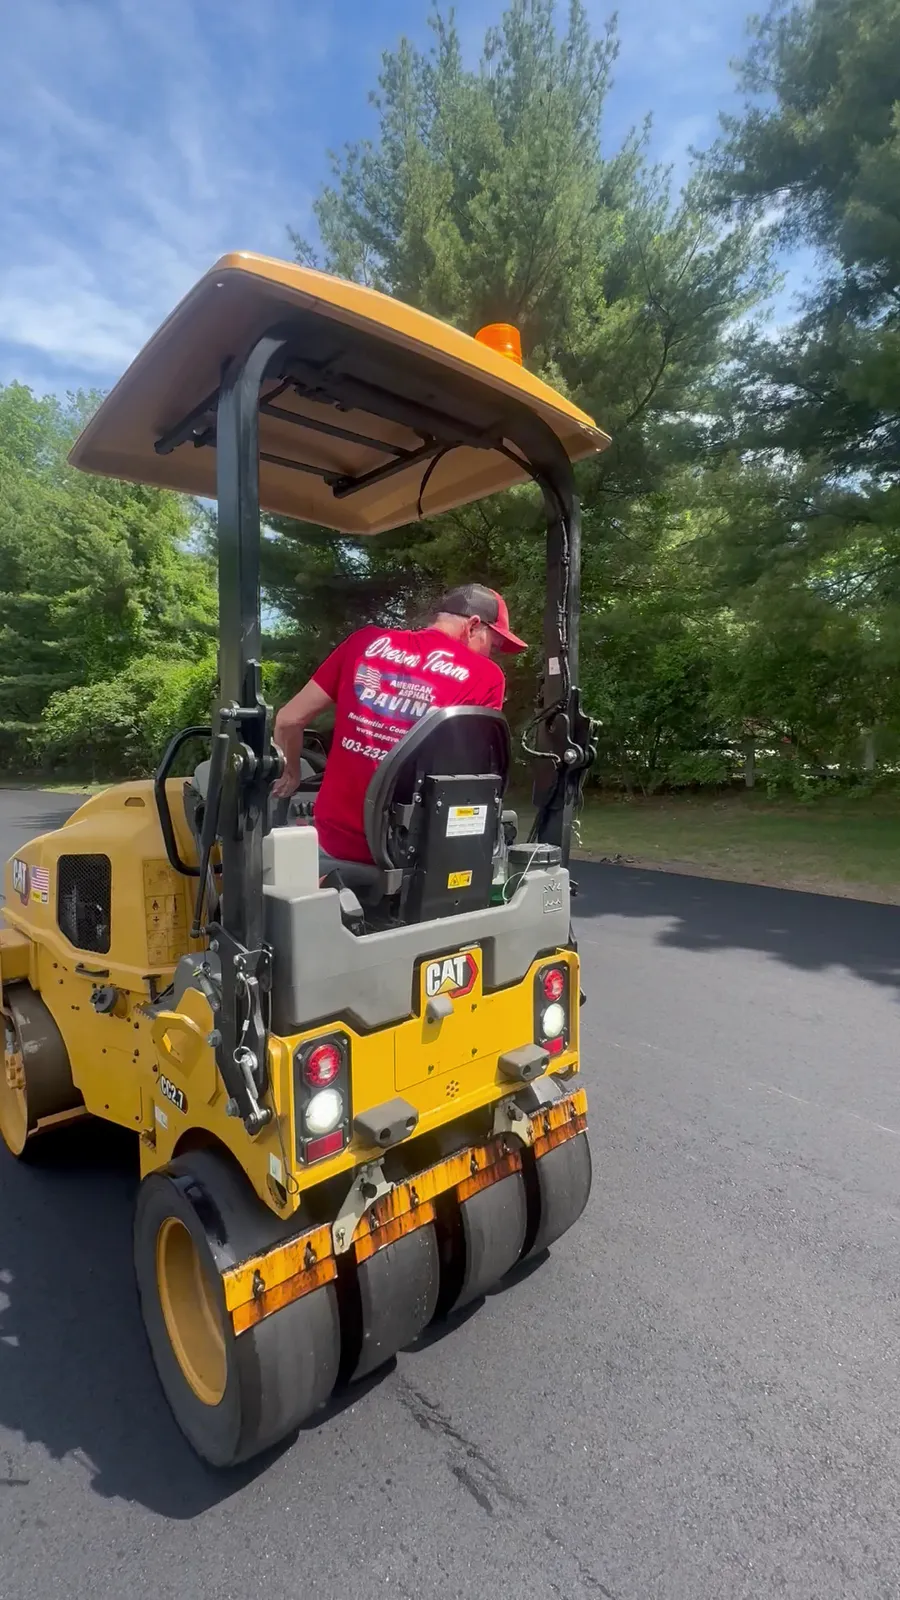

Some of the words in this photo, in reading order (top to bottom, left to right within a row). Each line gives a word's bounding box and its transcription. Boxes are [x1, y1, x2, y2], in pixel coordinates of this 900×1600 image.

[365, 637, 420, 667] Dream
[423, 650, 470, 681] Team
[359, 687, 440, 717] PAVIN
[389, 680, 433, 695] AMERICAN
[398, 689, 436, 703] ASPHALT
[348, 712, 385, 729] Residential
[13, 858, 27, 895] CAT
[426, 955, 467, 996] CAT
